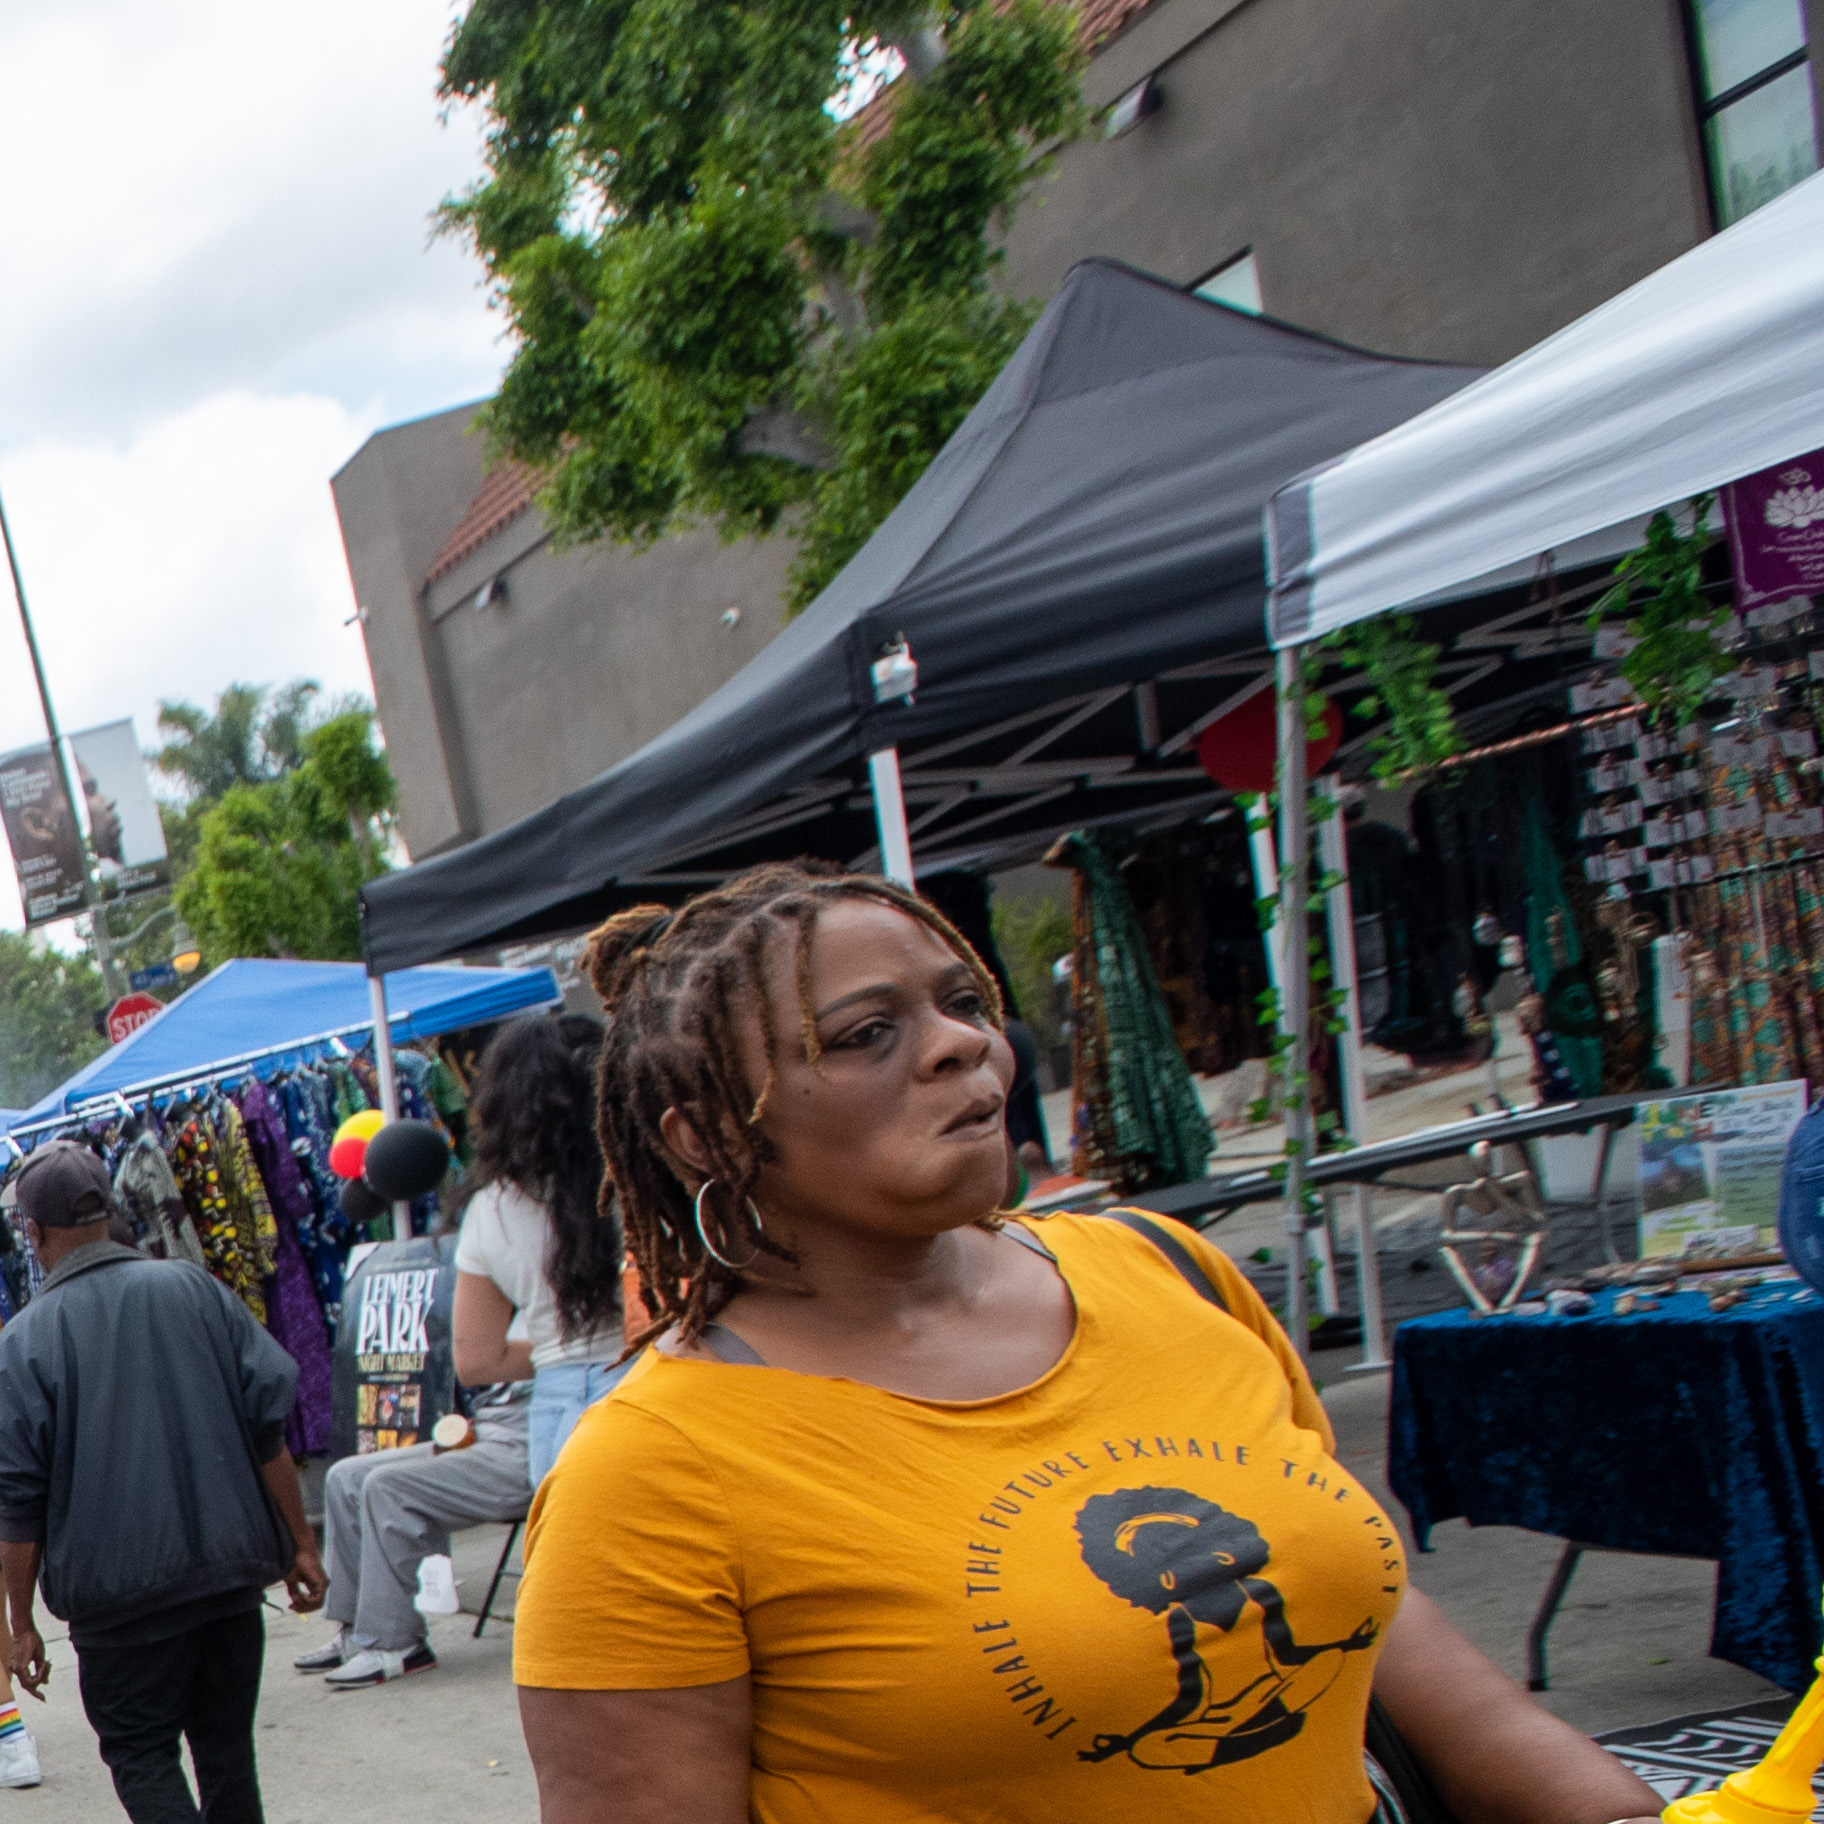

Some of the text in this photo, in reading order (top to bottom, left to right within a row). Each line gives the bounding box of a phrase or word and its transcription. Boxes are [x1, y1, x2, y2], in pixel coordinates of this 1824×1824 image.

[363, 1269, 439, 1304] LEIMERT
[355, 1300, 434, 1355] PARK
[966, 1437, 1399, 1742] INHALE THE FUTURE EXHALE THE PAST
